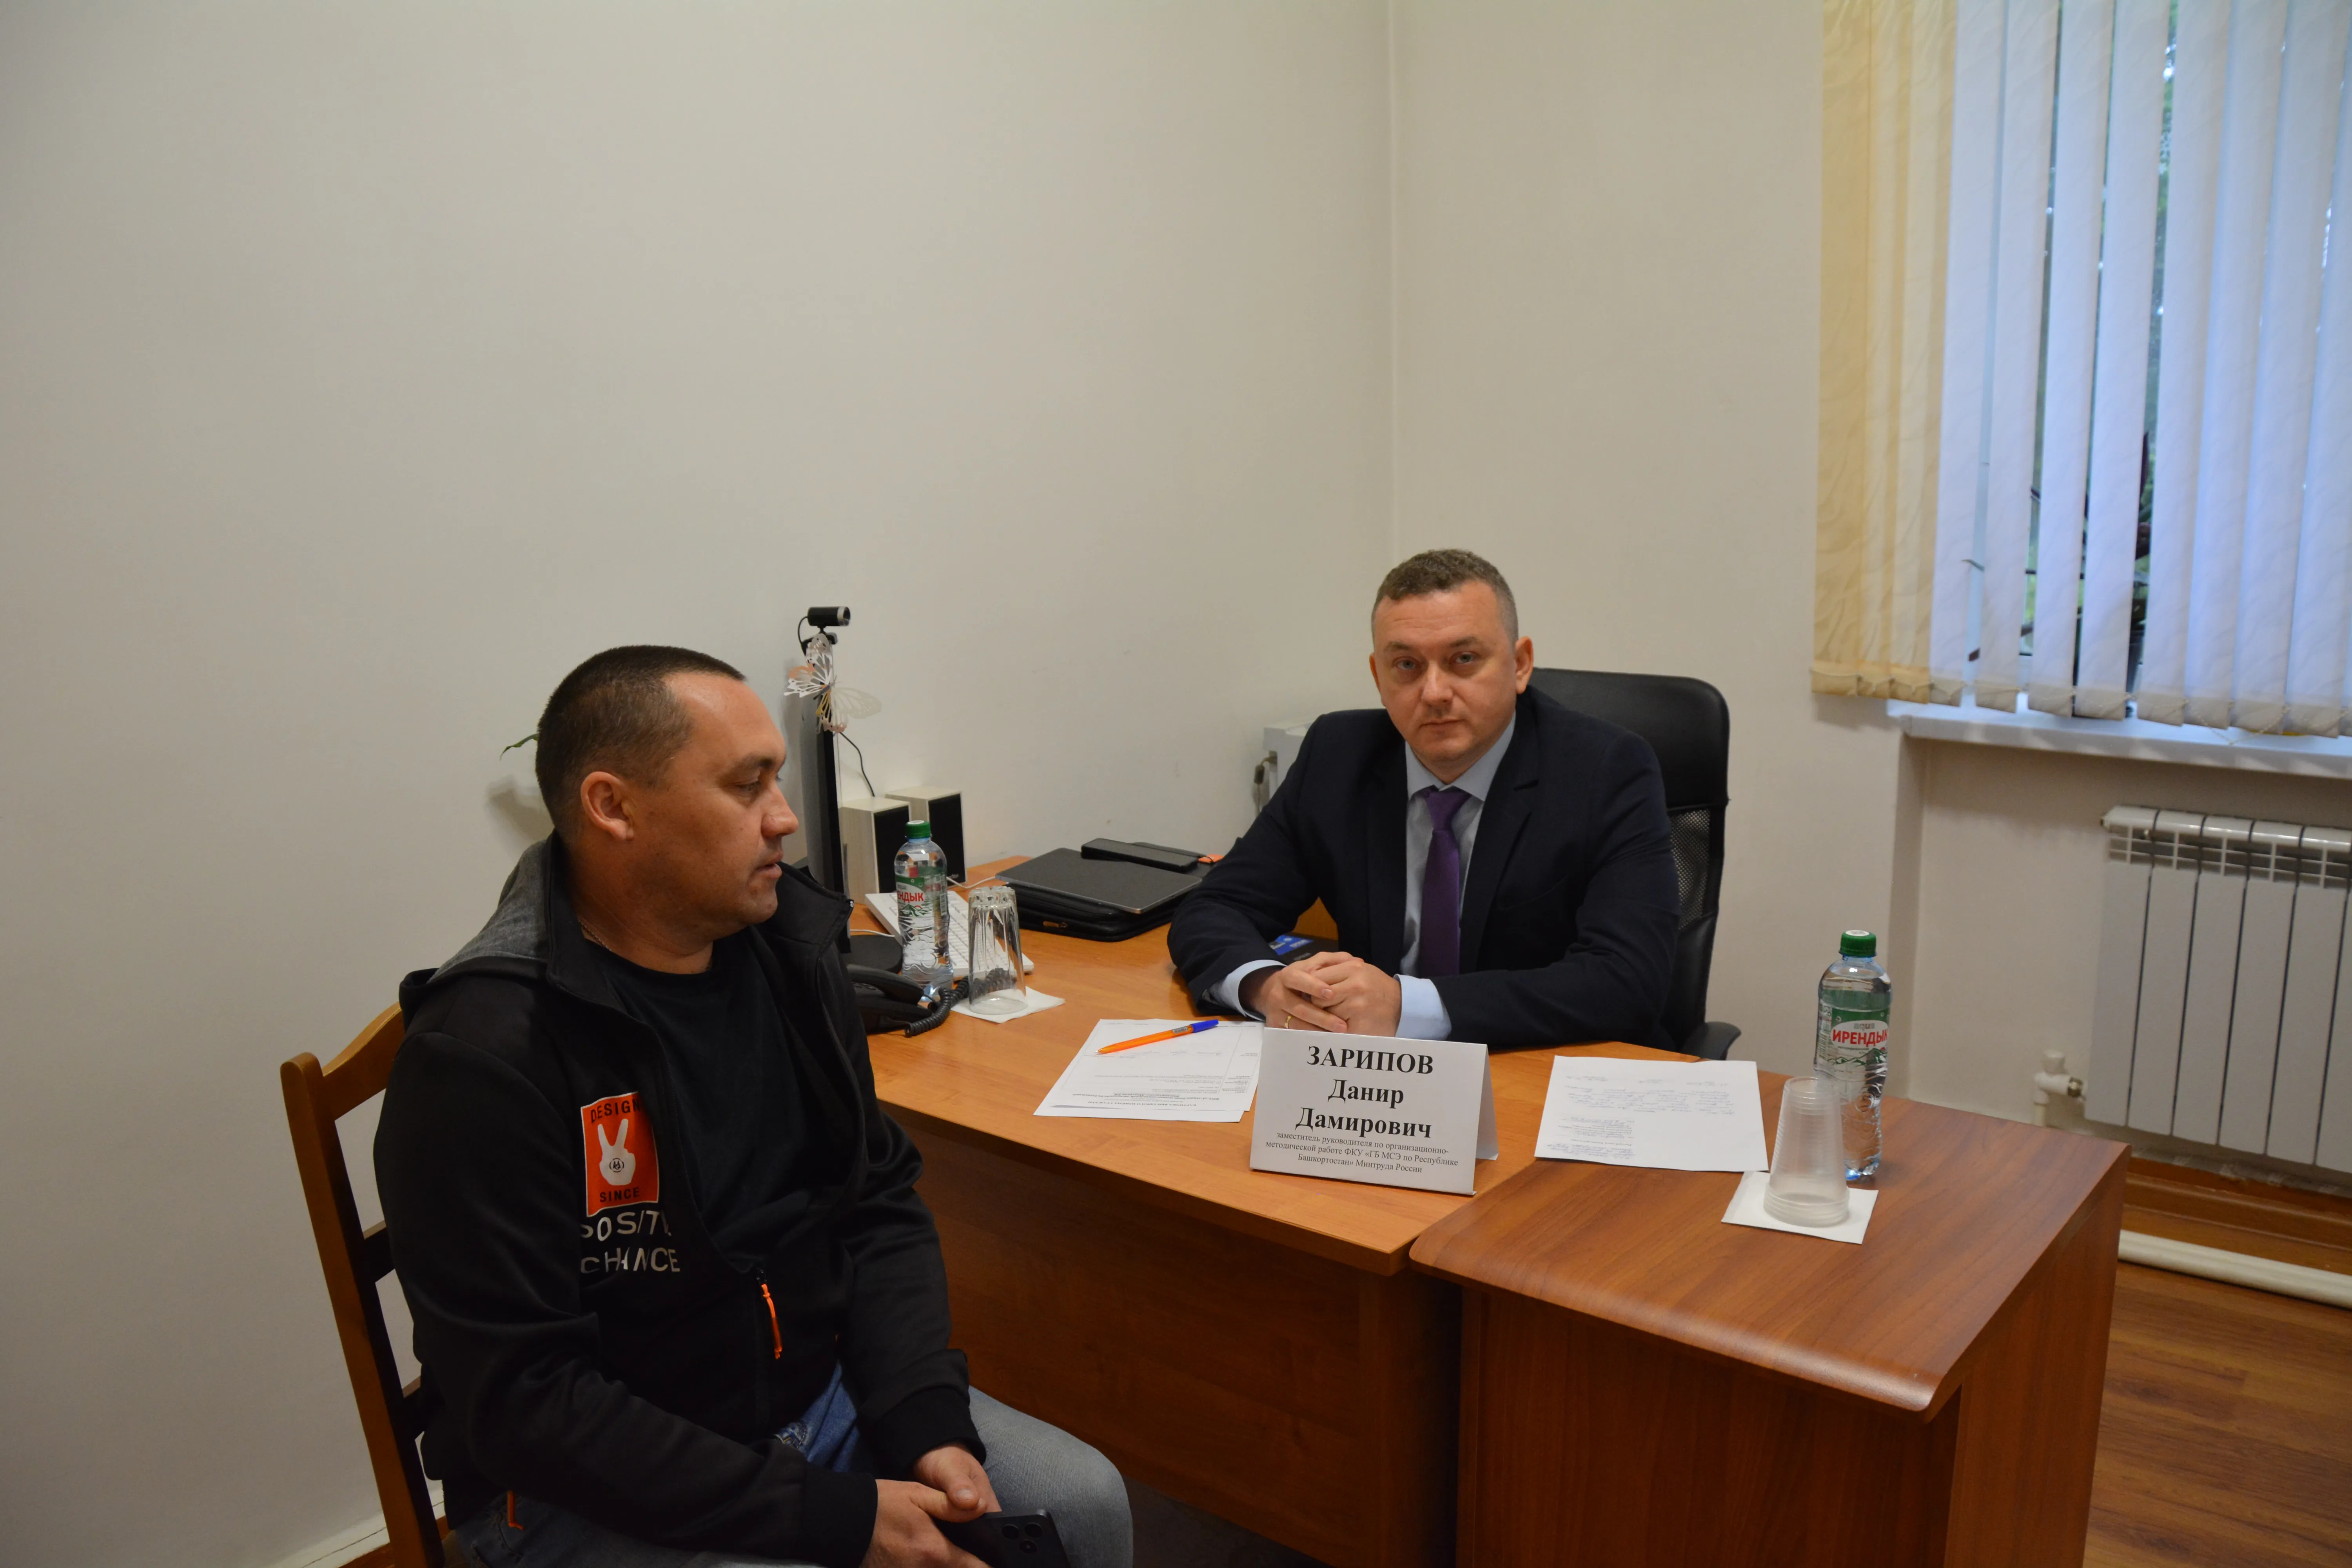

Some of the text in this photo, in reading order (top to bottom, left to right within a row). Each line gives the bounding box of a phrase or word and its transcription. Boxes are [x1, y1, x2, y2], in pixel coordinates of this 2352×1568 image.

[1307, 1045, 1433, 1074] ЗАРИПОВ
[1328, 1079, 1404, 1109] Данир
[1295, 1107, 1432, 1138] Дамирович
[1266, 1142, 1316, 1152] методической
[1414, 1155, 1459, 1166] Республике
[1277, 1132, 1320, 1142] заместитель
[1322, 1137, 1372, 1147] руководителя
[1386, 1143, 1449, 1154] организационно-
[1298, 1153, 1422, 1173] Башкортостан» Минтруда России
[600, 1187, 639, 1202] SINCE
